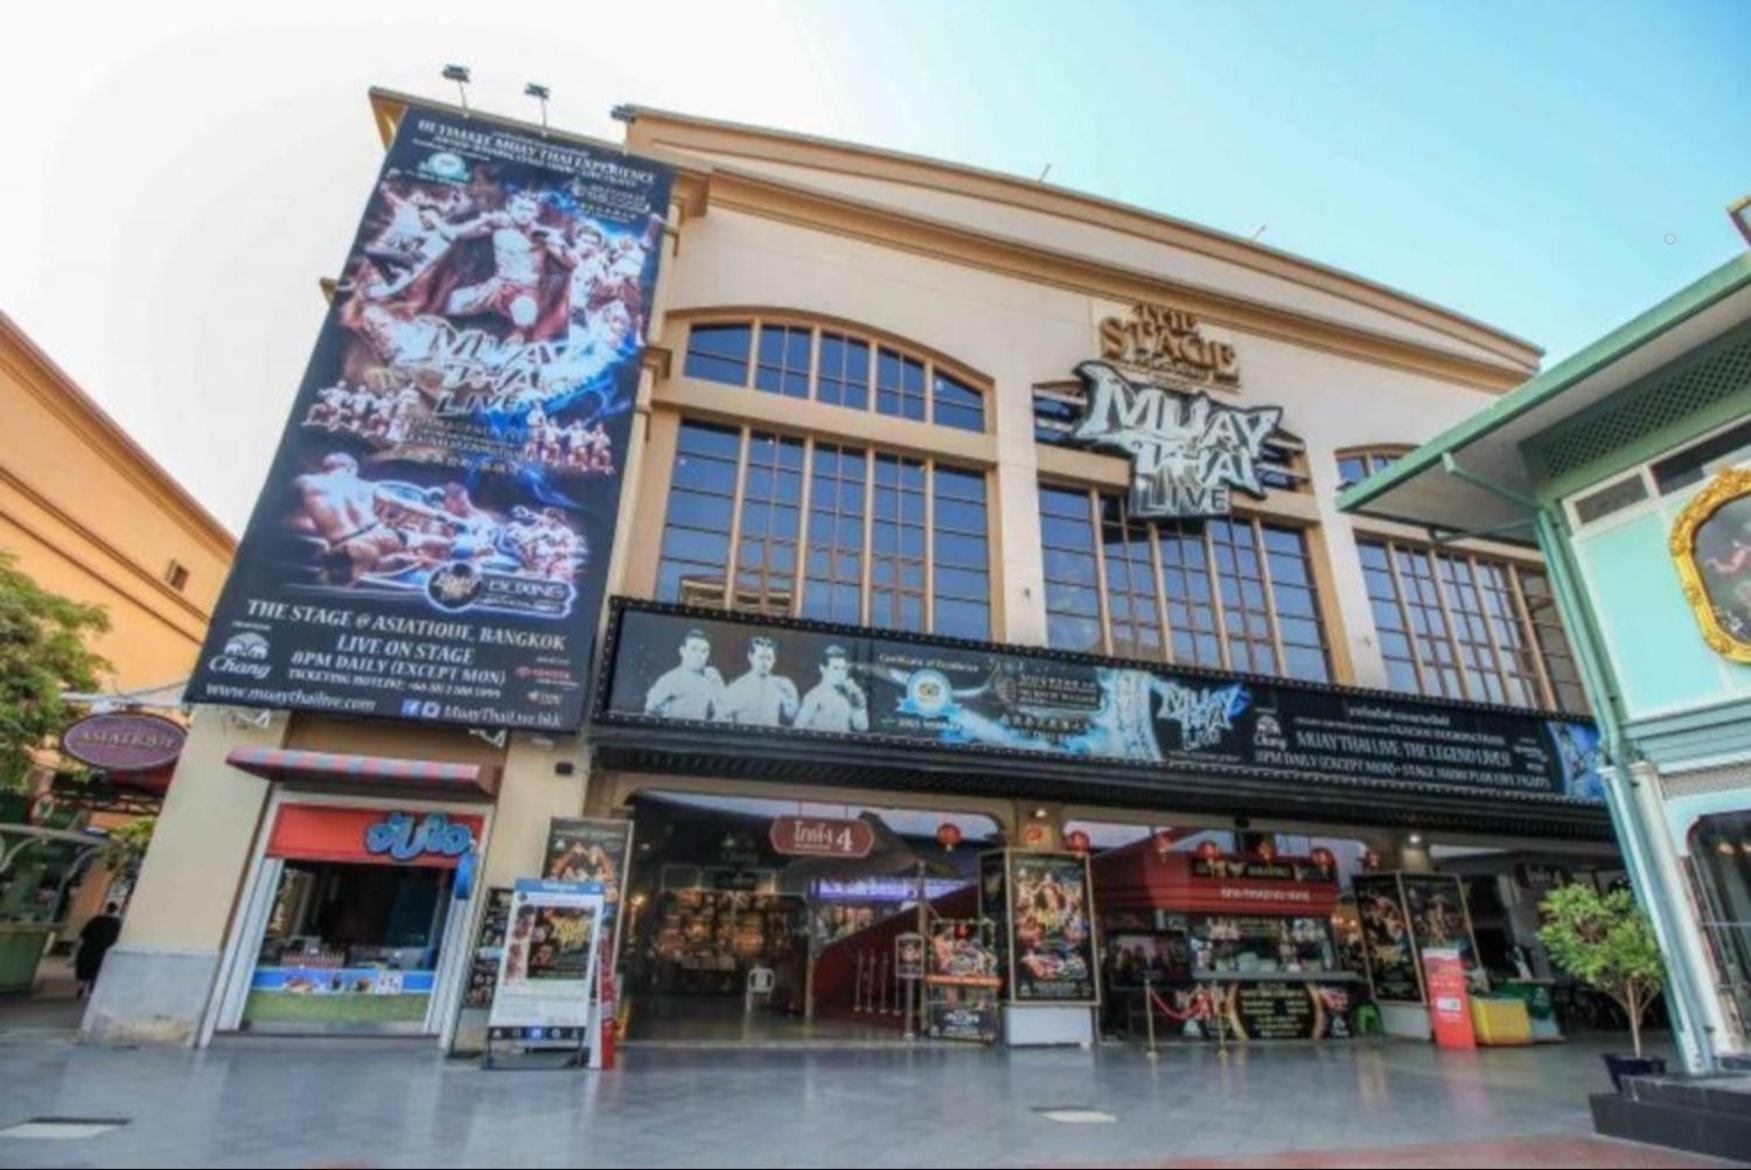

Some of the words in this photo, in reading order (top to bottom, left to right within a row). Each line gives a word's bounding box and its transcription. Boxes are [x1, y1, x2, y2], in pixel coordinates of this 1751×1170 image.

[576, 150, 656, 184] EXPERIENCE
[1099, 316, 1239, 381] STAGE
[1072, 360, 1283, 455] MUAY
[1131, 440, 1267, 500] THAI
[1130, 478, 1231, 517] LIVE
[248, 599, 289, 620] THE
[290, 605, 353, 627] STAGE
[479, 627, 568, 651] BANGKOK
[336, 634, 383, 655] LIVE
[385, 639, 413, 657] ON
[415, 643, 476, 665] STAGE
[208, 655, 272, 680] Chang
[291, 651, 332, 668] 8PM
[335, 653, 389, 674] DAILY
[390, 659, 459, 681] (EXCEPT
[463, 669, 507, 687] MON)
[206, 683, 377, 712] www.muaythailive.com
[1254, 733, 1287, 750] Chang
[836, 827, 853, 851] 4
